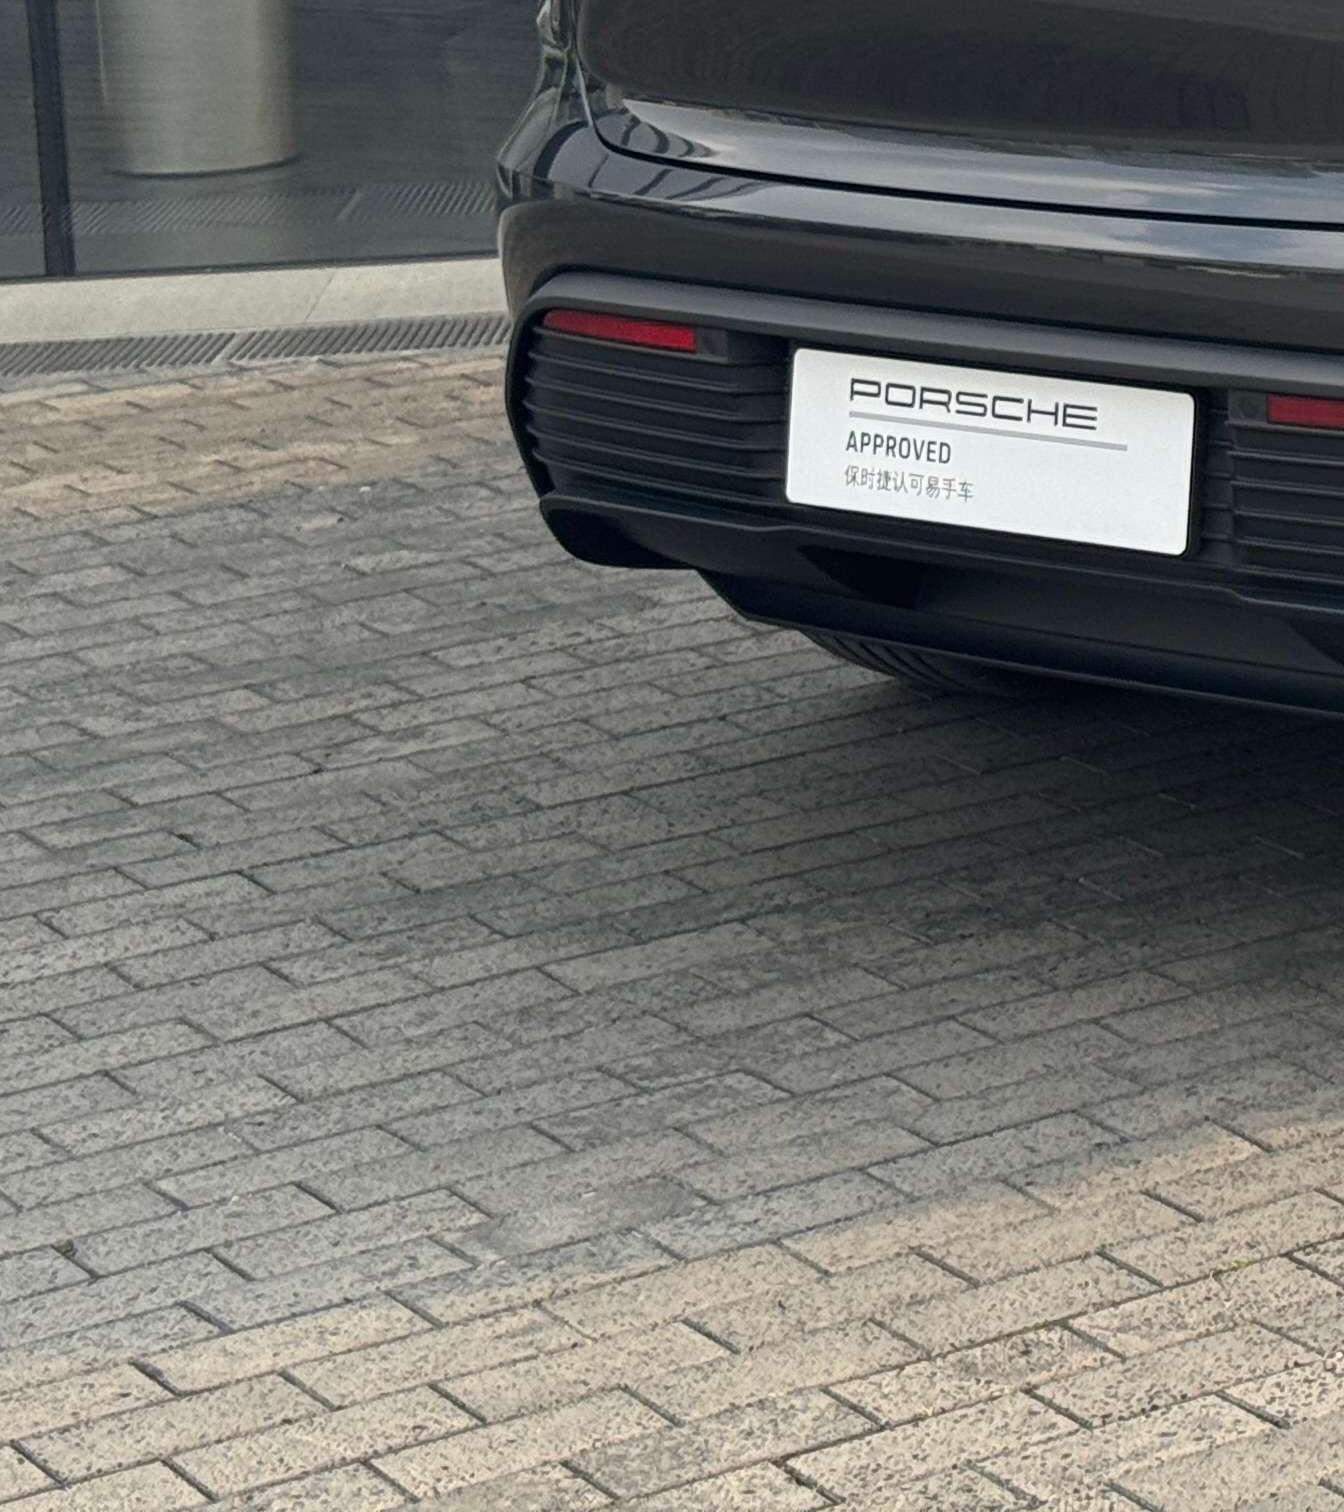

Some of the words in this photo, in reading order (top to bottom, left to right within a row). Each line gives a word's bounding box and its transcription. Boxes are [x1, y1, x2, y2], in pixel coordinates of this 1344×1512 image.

[849, 377, 1098, 431] PORSCHE
[845, 430, 952, 465] APPROVED
[844, 464, 974, 503] 保时捷认可易手车
